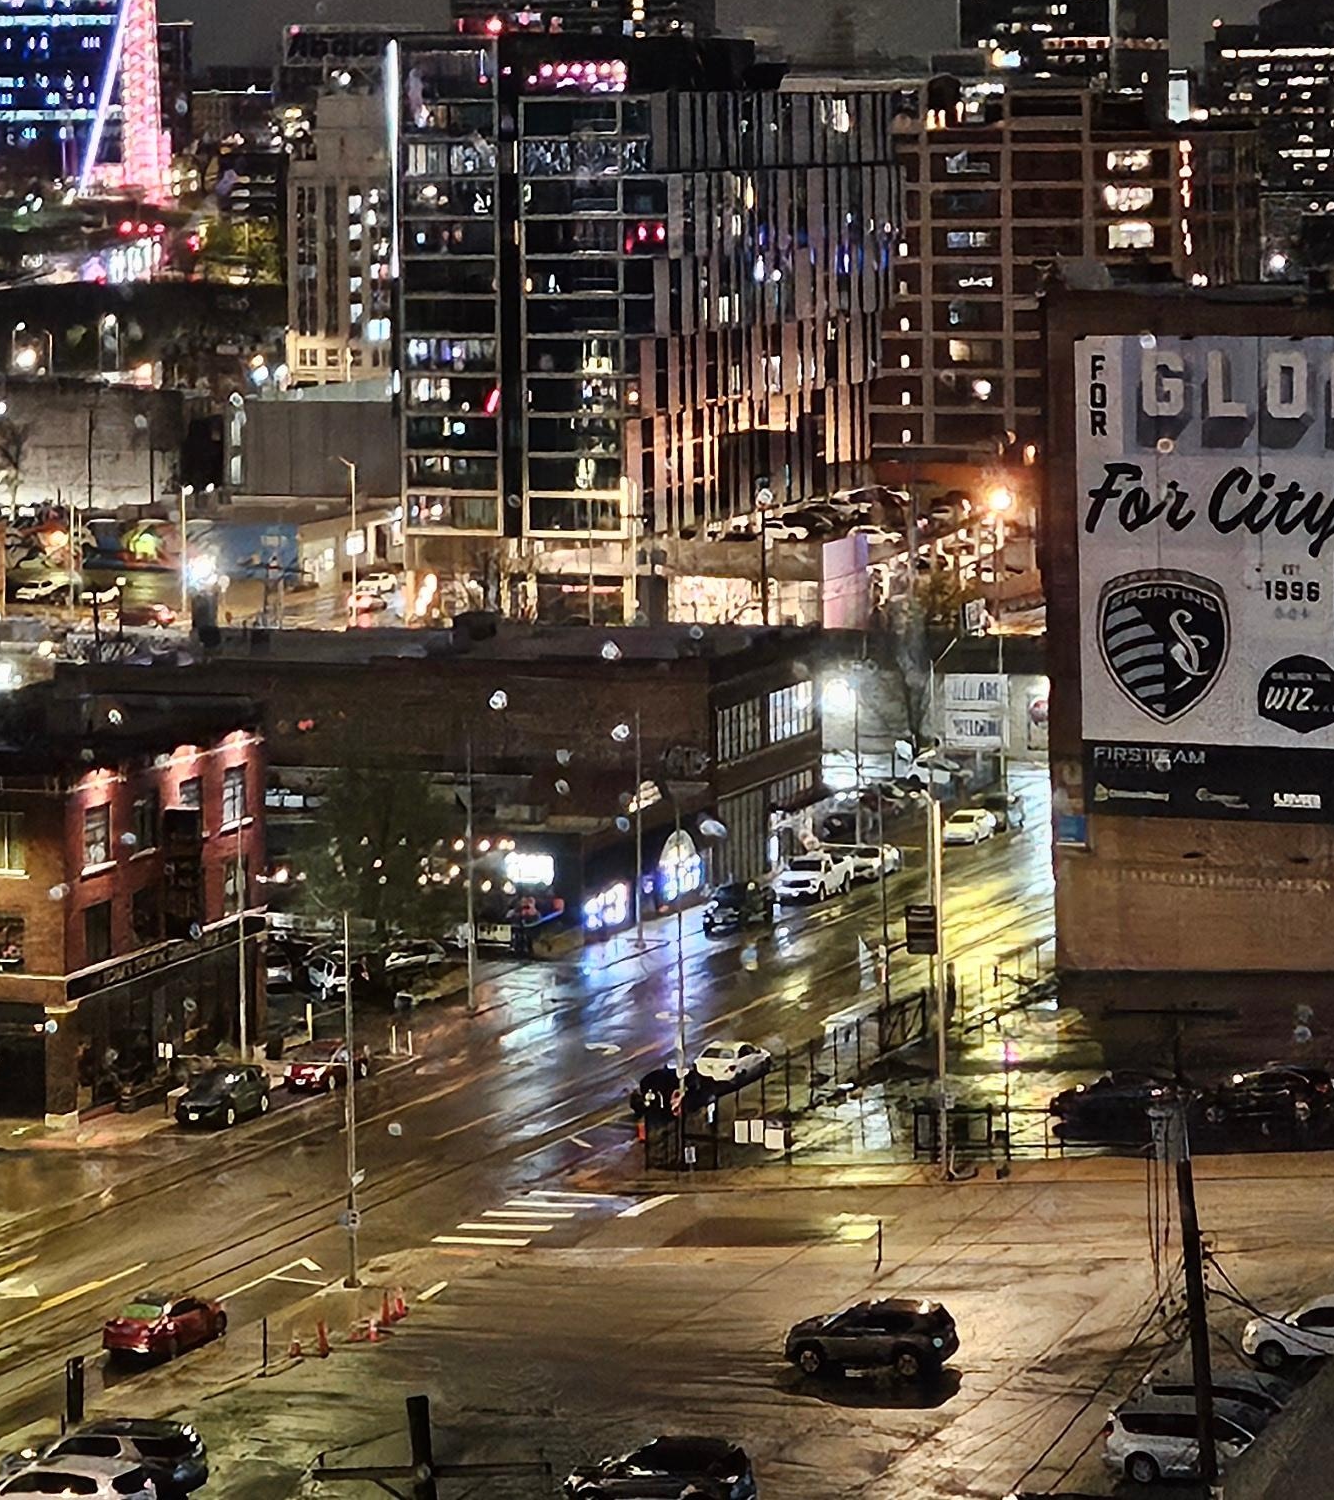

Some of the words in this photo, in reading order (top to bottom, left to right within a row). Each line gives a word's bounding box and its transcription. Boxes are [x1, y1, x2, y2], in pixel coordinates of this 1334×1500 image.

[1089, 354, 1107, 437] FOR
[1084, 462, 1196, 534] For
[1264, 579, 1321, 603] 1996
[1264, 685, 1314, 713] WIZ
